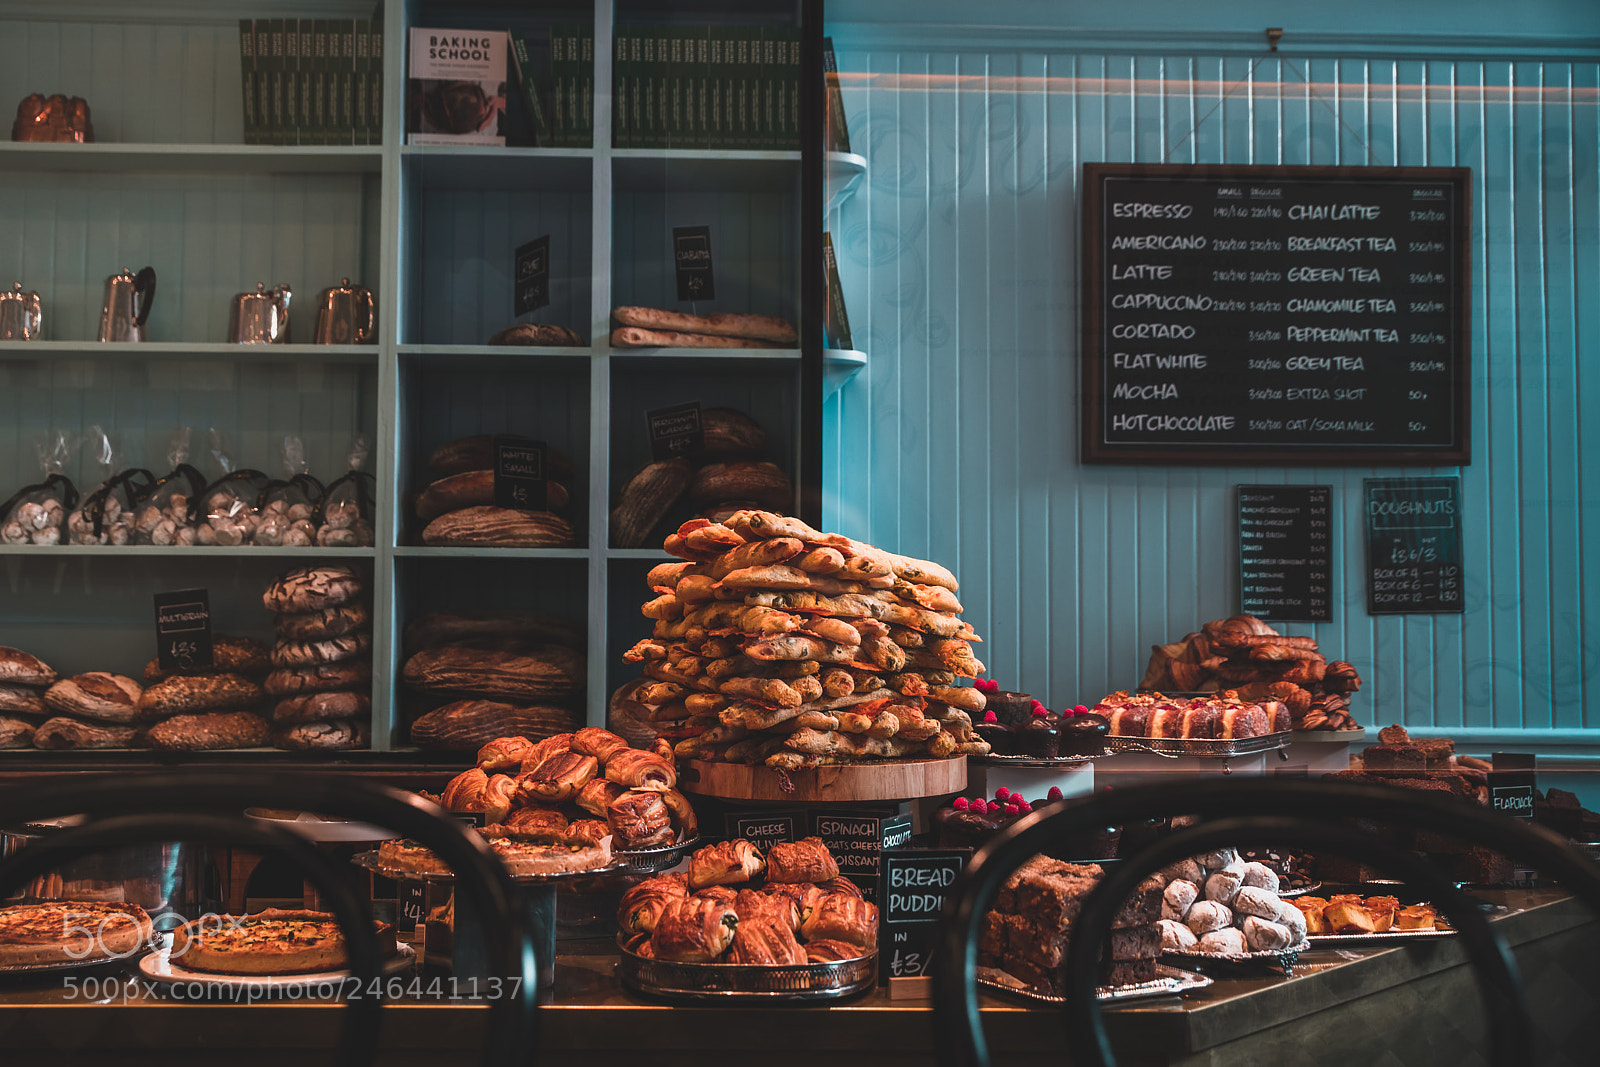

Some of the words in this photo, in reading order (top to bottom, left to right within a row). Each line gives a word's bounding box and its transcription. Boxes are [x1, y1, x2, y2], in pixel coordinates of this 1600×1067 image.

[430, 35, 490, 49] BAKING
[429, 48, 491, 61] SCHOOL
[1113, 203, 1193, 219] ESPRESSO
[1288, 204, 1328, 220] CHAI
[1330, 203, 1381, 220] LATTE
[1112, 234, 1207, 250] AMERICANO
[1287, 235, 1366, 252] BREAKFAST
[1366, 237, 1397, 252] TEA
[1112, 264, 1173, 280] LATTE
[1287, 266, 1345, 282] GREEN
[1347, 267, 1381, 282] TEA
[1112, 293, 1212, 311] CAPPUCCINO
[1286, 298, 1366, 313] CHAMOMILE
[1367, 299, 1397, 313] TEA
[1112, 323, 1196, 339] CORTADO
[1286, 325, 1371, 342] PEPPERMINT
[1371, 328, 1399, 343] TEA
[1113, 352, 1156, 369] FLAT
[1156, 353, 1208, 369] WHITE
[1285, 355, 1331, 371] GREY
[1332, 355, 1365, 371] TEA
[1113, 383, 1179, 400] MOCHA
[1286, 387, 1331, 400] EXTRA
[1334, 388, 1367, 400] SHOT
[1113, 414, 1147, 431] HOT
[1147, 414, 1235, 431] CHOCOLATE
[1346, 421, 1375, 432] MILK
[502, 450, 535, 461] WHITE
[503, 462, 537, 474] SMALL
[1370, 500, 1455, 515] DOUGHNUTS
[1373, 568, 1394, 579] BOX
[1395, 567, 1409, 578] OF
[1410, 567, 1419, 579] 4
[1374, 580, 1395, 591] BOX
[1396, 580, 1410, 591] OF
[1411, 579, 1421, 590] 6
[1374, 593, 1396, 603] BOX
[1397, 592, 1410, 603] OF
[1493, 795, 1533, 810] FLAPJACK
[746, 823, 786, 837] CHEESE
[821, 821, 875, 837] SPINACH
[850, 841, 881, 851] CHEESE
[883, 829, 912, 848] CHOCOLATE
[835, 854, 881, 867] OISSANT
[891, 867, 955, 888] BREAD
[412, 888, 422, 897] IN
[890, 893, 944, 913] PUDDI
[894, 931, 908, 942] IN
